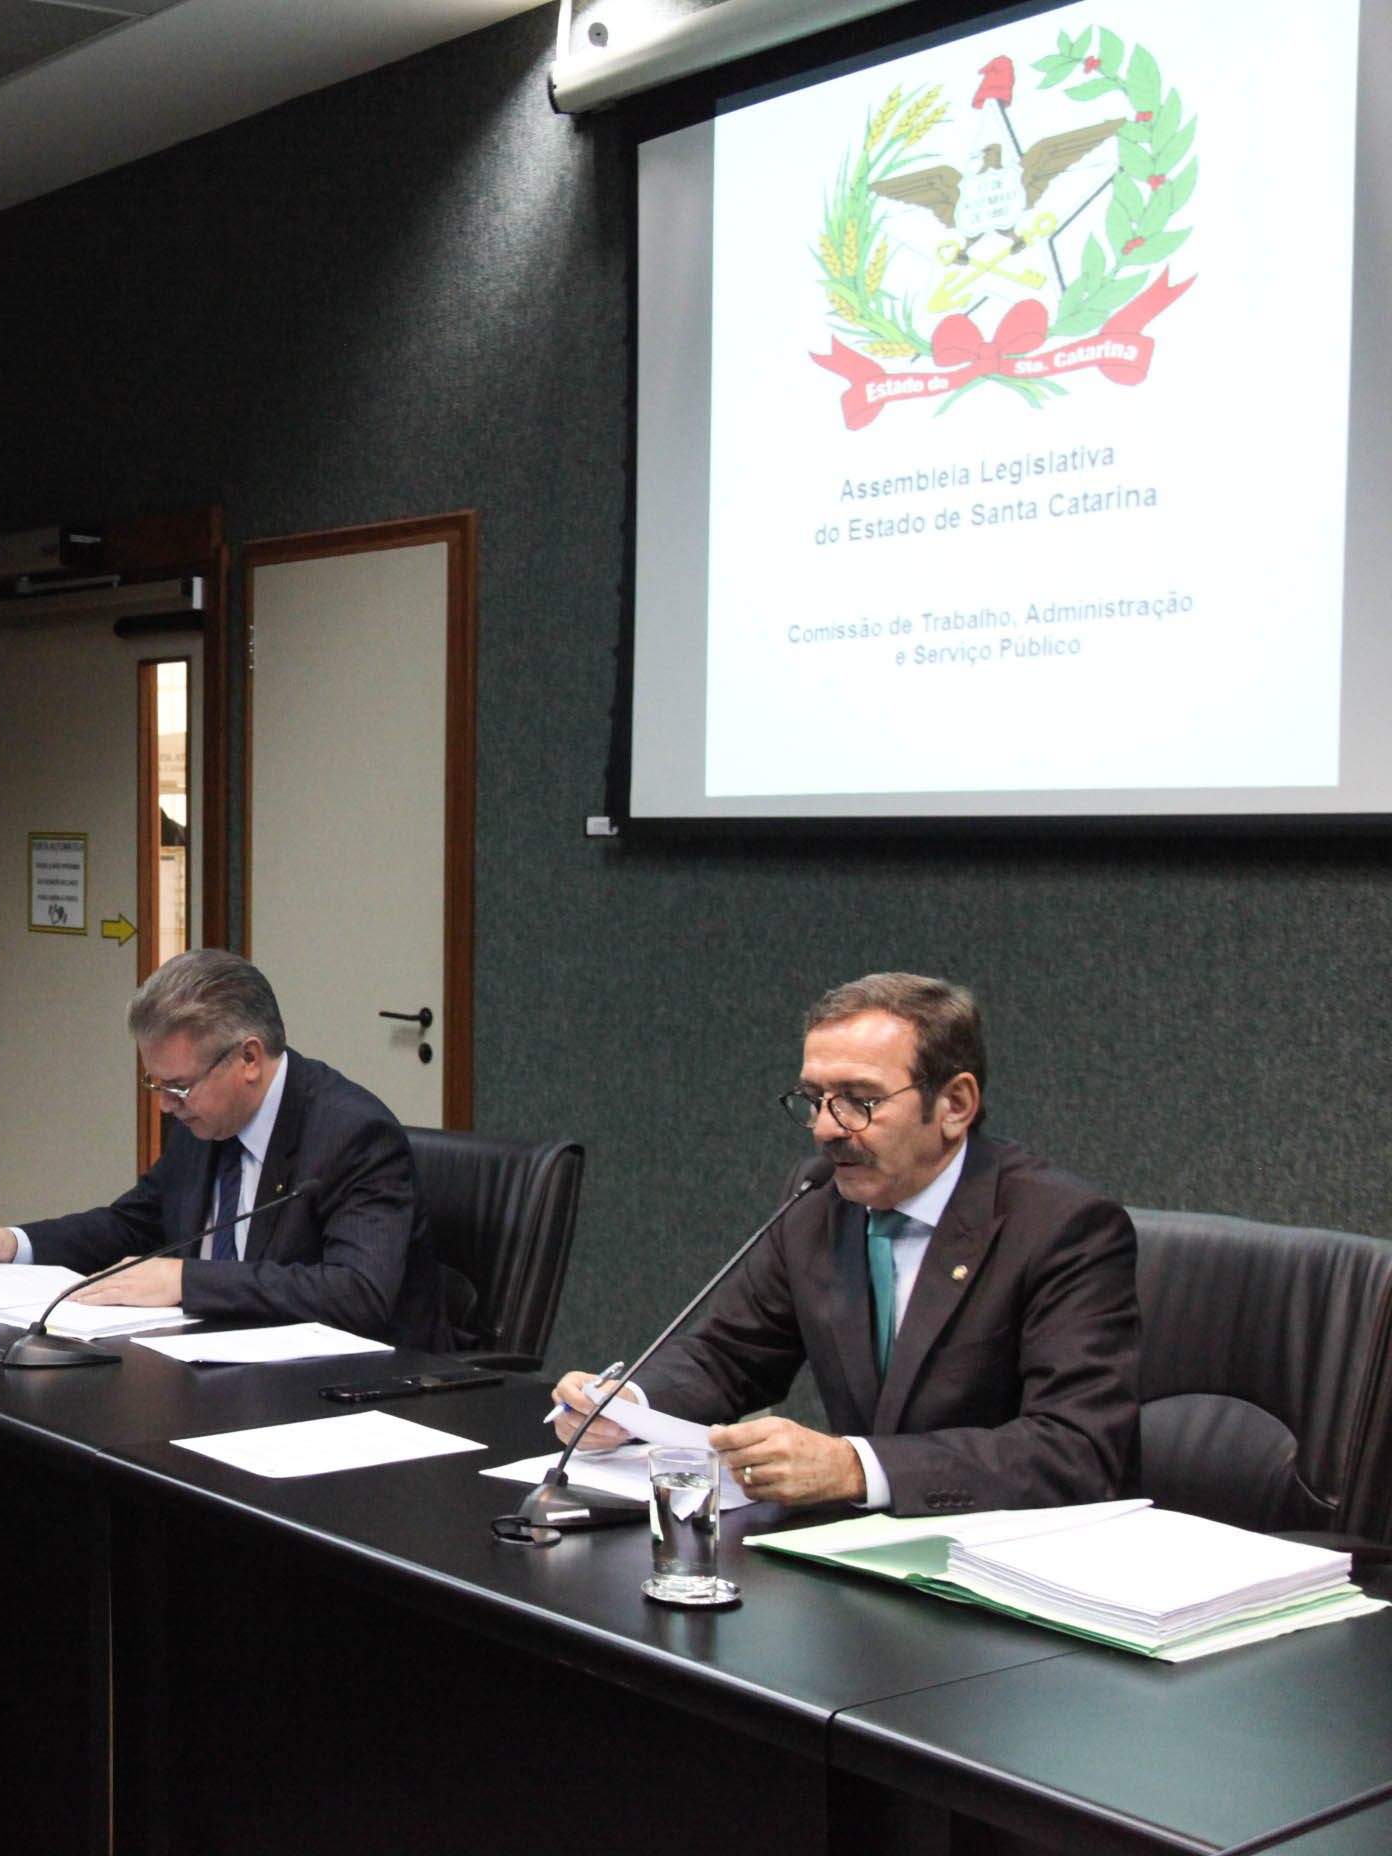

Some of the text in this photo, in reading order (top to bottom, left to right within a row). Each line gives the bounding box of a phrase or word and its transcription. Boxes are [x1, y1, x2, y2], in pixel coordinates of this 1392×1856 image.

[865, 377, 924, 403] Estado
[1053, 339, 1138, 368] Catarina
[840, 443, 1115, 502] Assembleia Legislativa
[814, 483, 1158, 546] do Estado de Santa Catarina
[787, 591, 1195, 644] Comissão de Trabalho, Administração
[895, 634, 1082, 667] e Serviço Público
